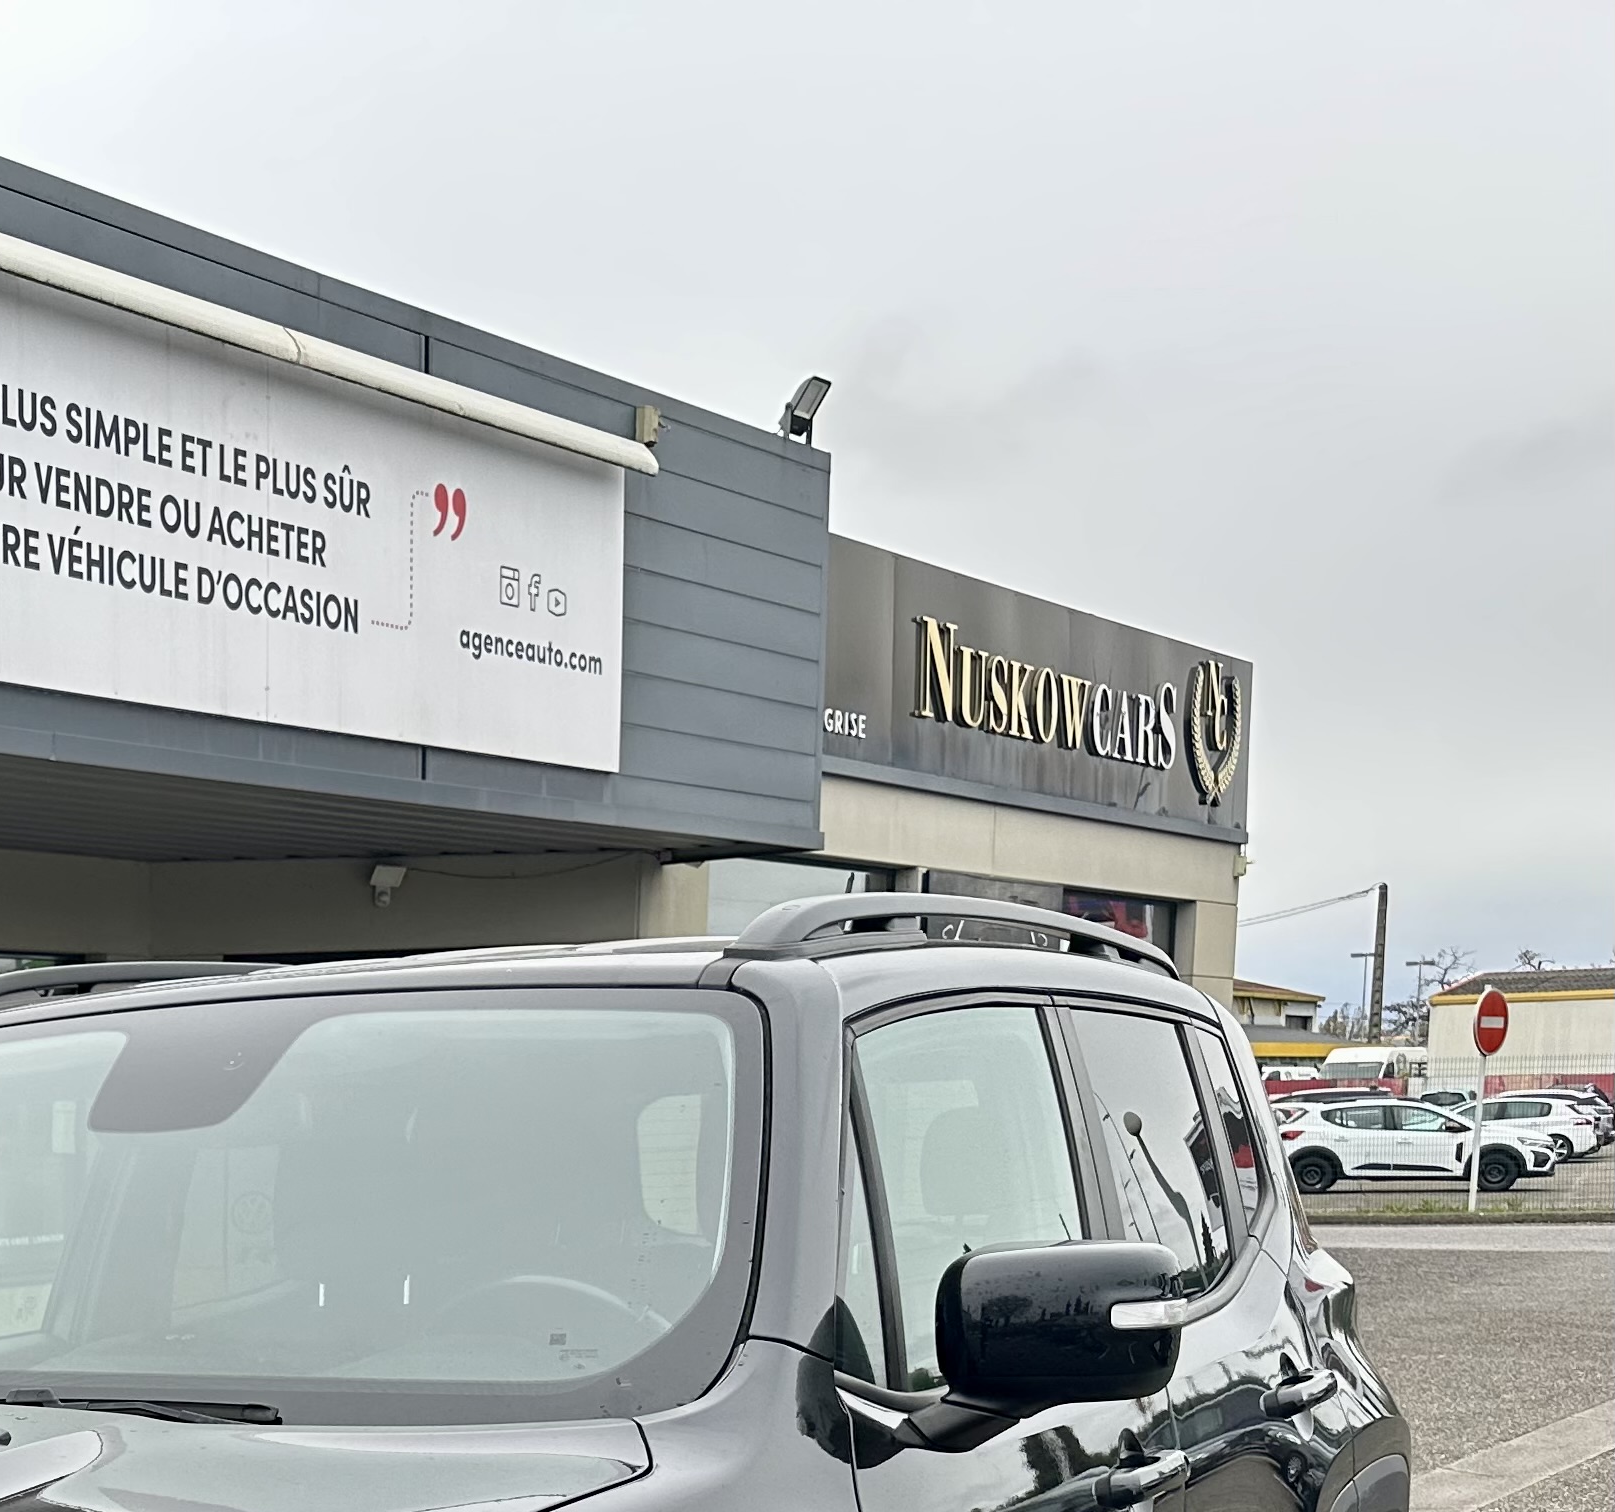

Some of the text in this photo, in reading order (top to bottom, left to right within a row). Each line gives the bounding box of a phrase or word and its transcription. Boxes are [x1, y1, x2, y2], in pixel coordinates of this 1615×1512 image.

[65, 402, 174, 468] SIMPLE
[180, 432, 213, 476] ET
[218, 445, 247, 487] LE
[255, 453, 317, 505] PLUS
[322, 464, 371, 519] SÛR
[33, 461, 153, 528] VENDRE
[159, 492, 200, 538] OU
[207, 506, 327, 568] ACHETER
[46, 526, 190, 602] VÉHICULE
[196, 565, 360, 635] D'OCCASION
[459, 627, 603, 677] agenceauto.com
[824, 707, 867, 739] GRISE
